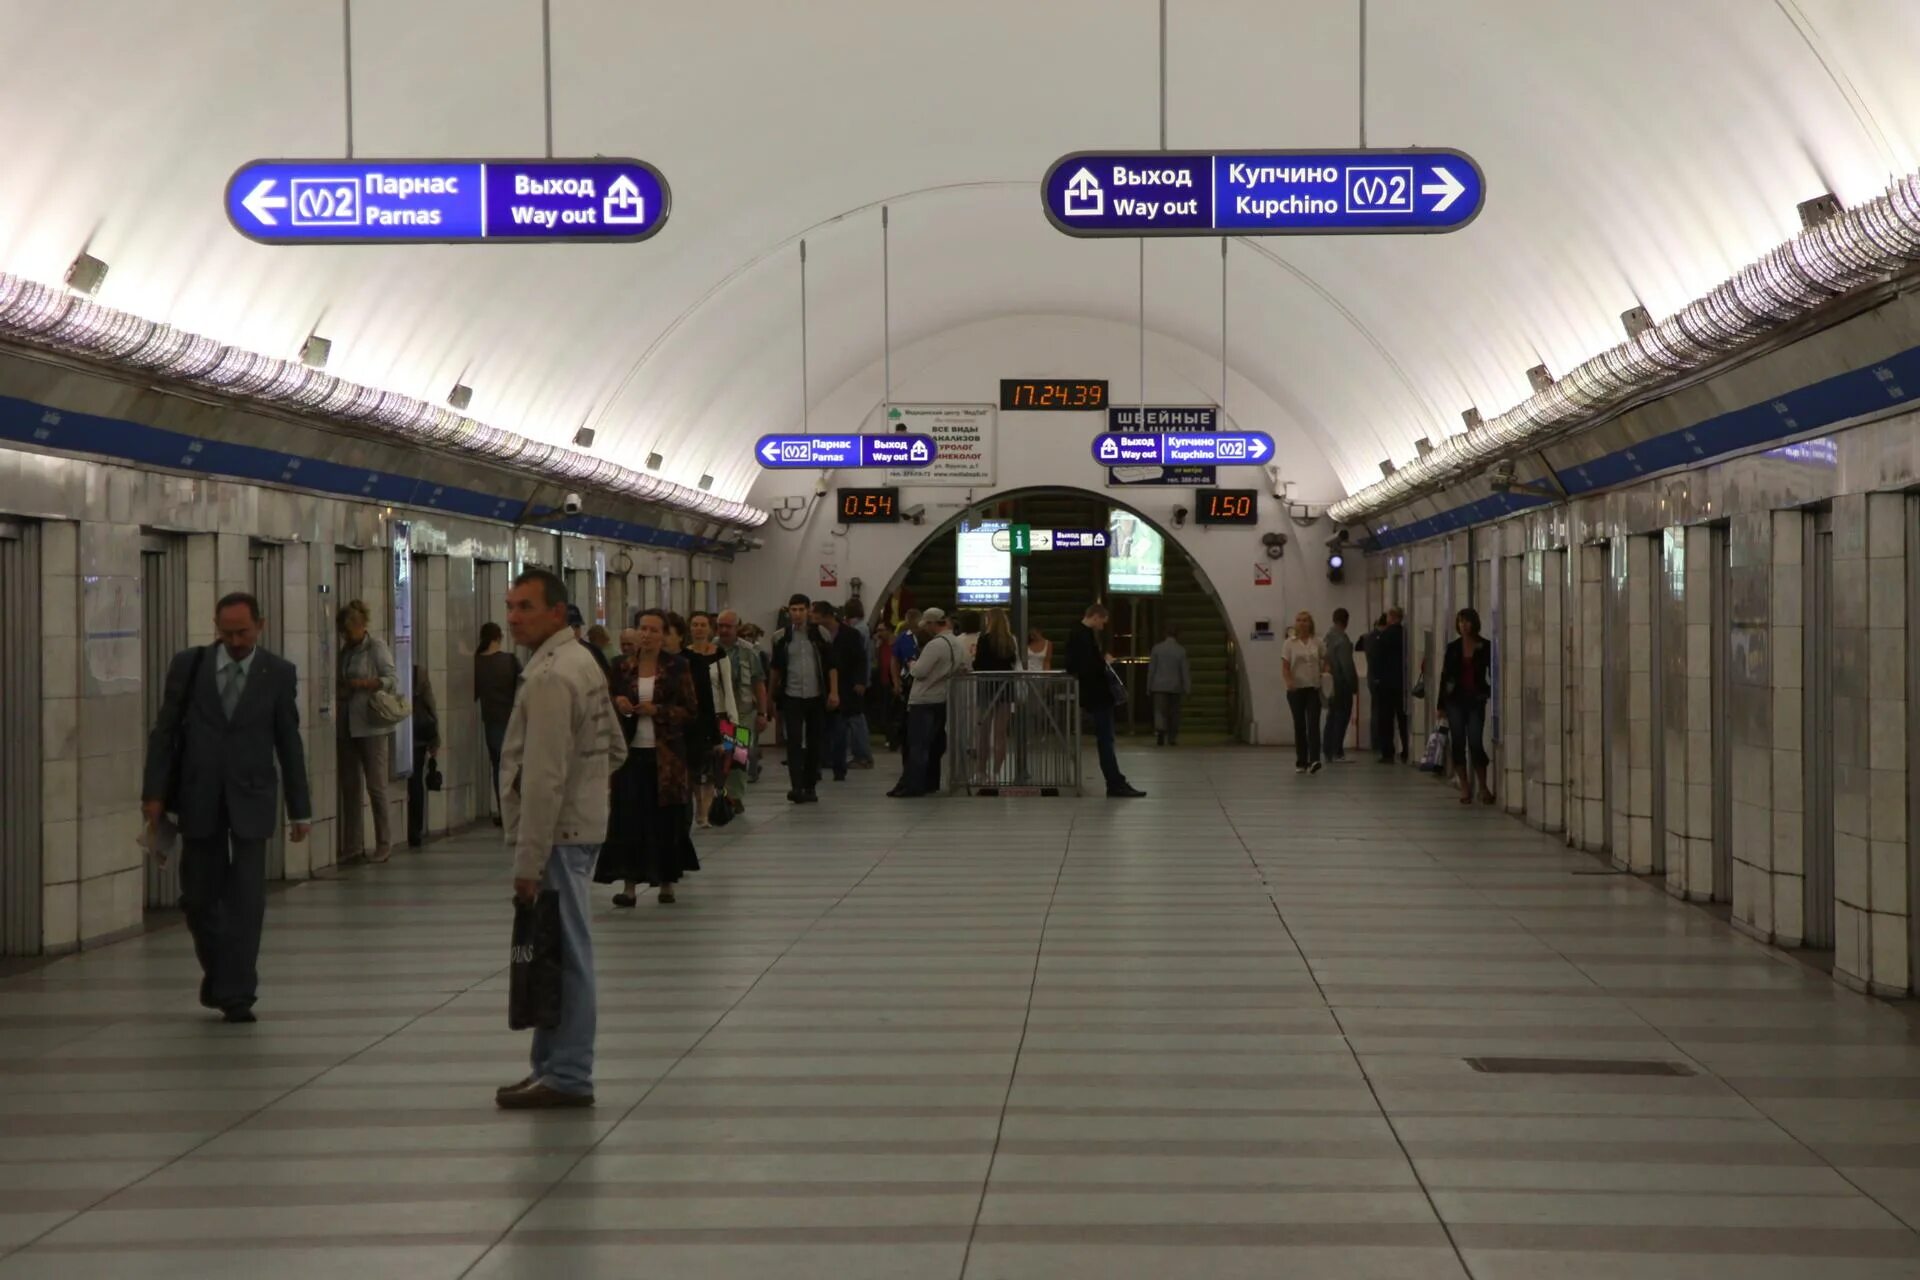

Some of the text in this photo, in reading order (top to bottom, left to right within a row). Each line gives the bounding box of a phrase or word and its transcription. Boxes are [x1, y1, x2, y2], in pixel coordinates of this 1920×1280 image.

[365, 173, 458, 196] Парнас
[1113, 167, 1192, 188] Выход
[1229, 163, 1338, 189] Купчино
[514, 175, 595, 198] Выход
[366, 207, 441, 226] Parnas
[1113, 199, 1198, 219] Way out
[1236, 195, 1338, 219] Kupchino
[511, 207, 597, 229] Way out
[951, 426, 979, 434] ВИДЫ
[812, 439, 852, 451] Парнас
[873, 439, 908, 450] Выход
[1121, 437, 1155, 447] Выход
[1168, 436, 1215, 448] Купчино
[812, 452, 844, 461] Parnas
[872, 453, 908, 463] Way out
[1121, 450, 1157, 460] Way out
[1171, 450, 1215, 460] Kupchino
[845, 495, 892, 516] 0.54
[1209, 496, 1250, 517] 1.50
